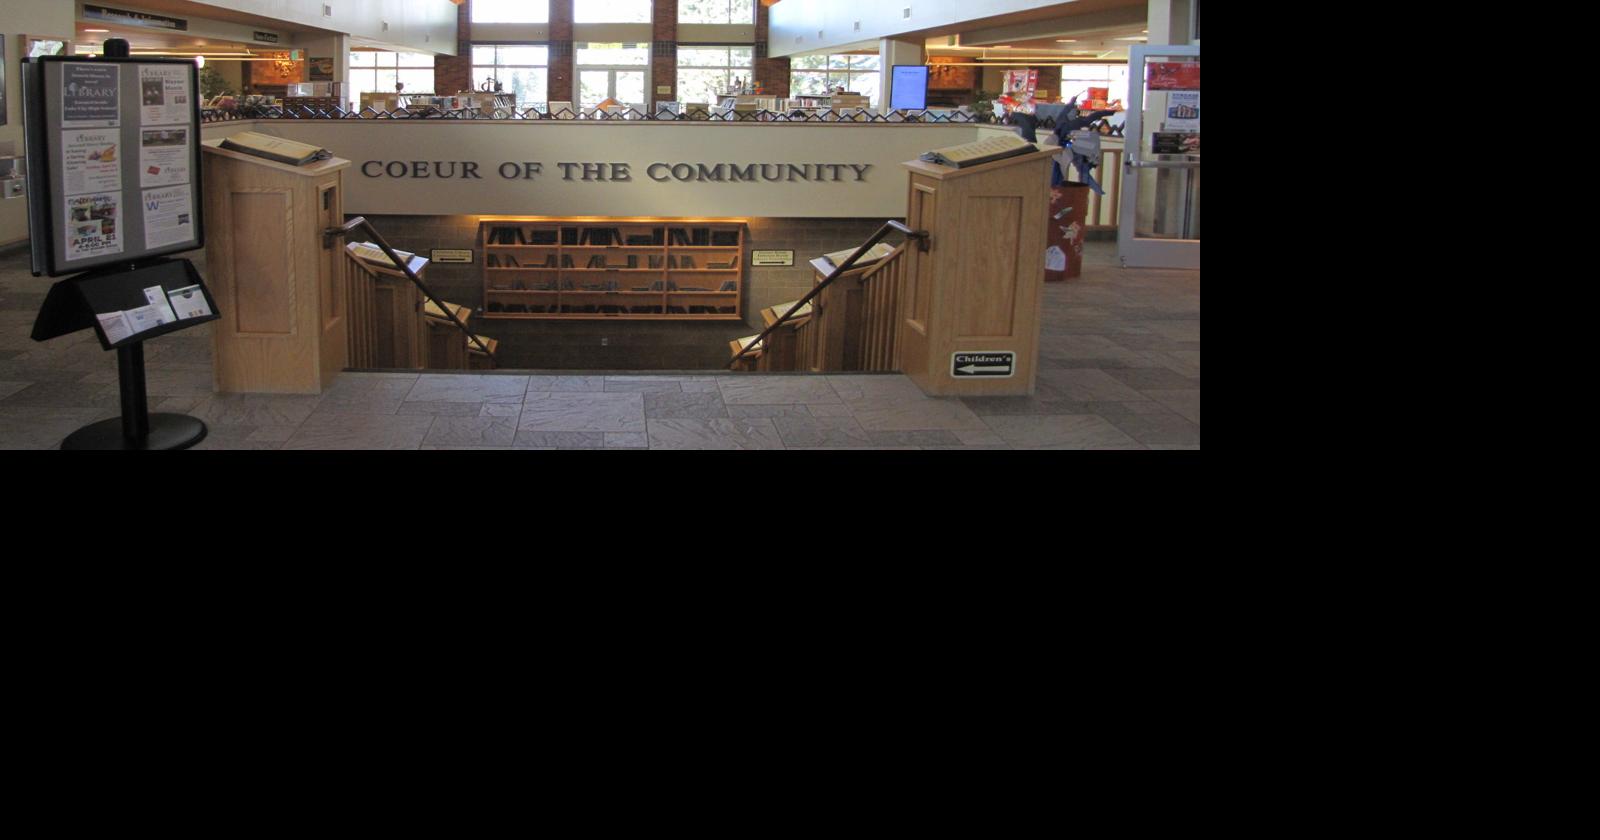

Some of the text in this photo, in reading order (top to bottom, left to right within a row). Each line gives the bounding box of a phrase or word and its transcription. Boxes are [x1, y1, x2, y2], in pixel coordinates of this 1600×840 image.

[64, 82, 116, 97] LIBRARY
[361, 160, 874, 183] COEUR OF THE COMMUNITY
[72, 236, 102, 247] APRIL
[956, 355, 1011, 363] Children's
